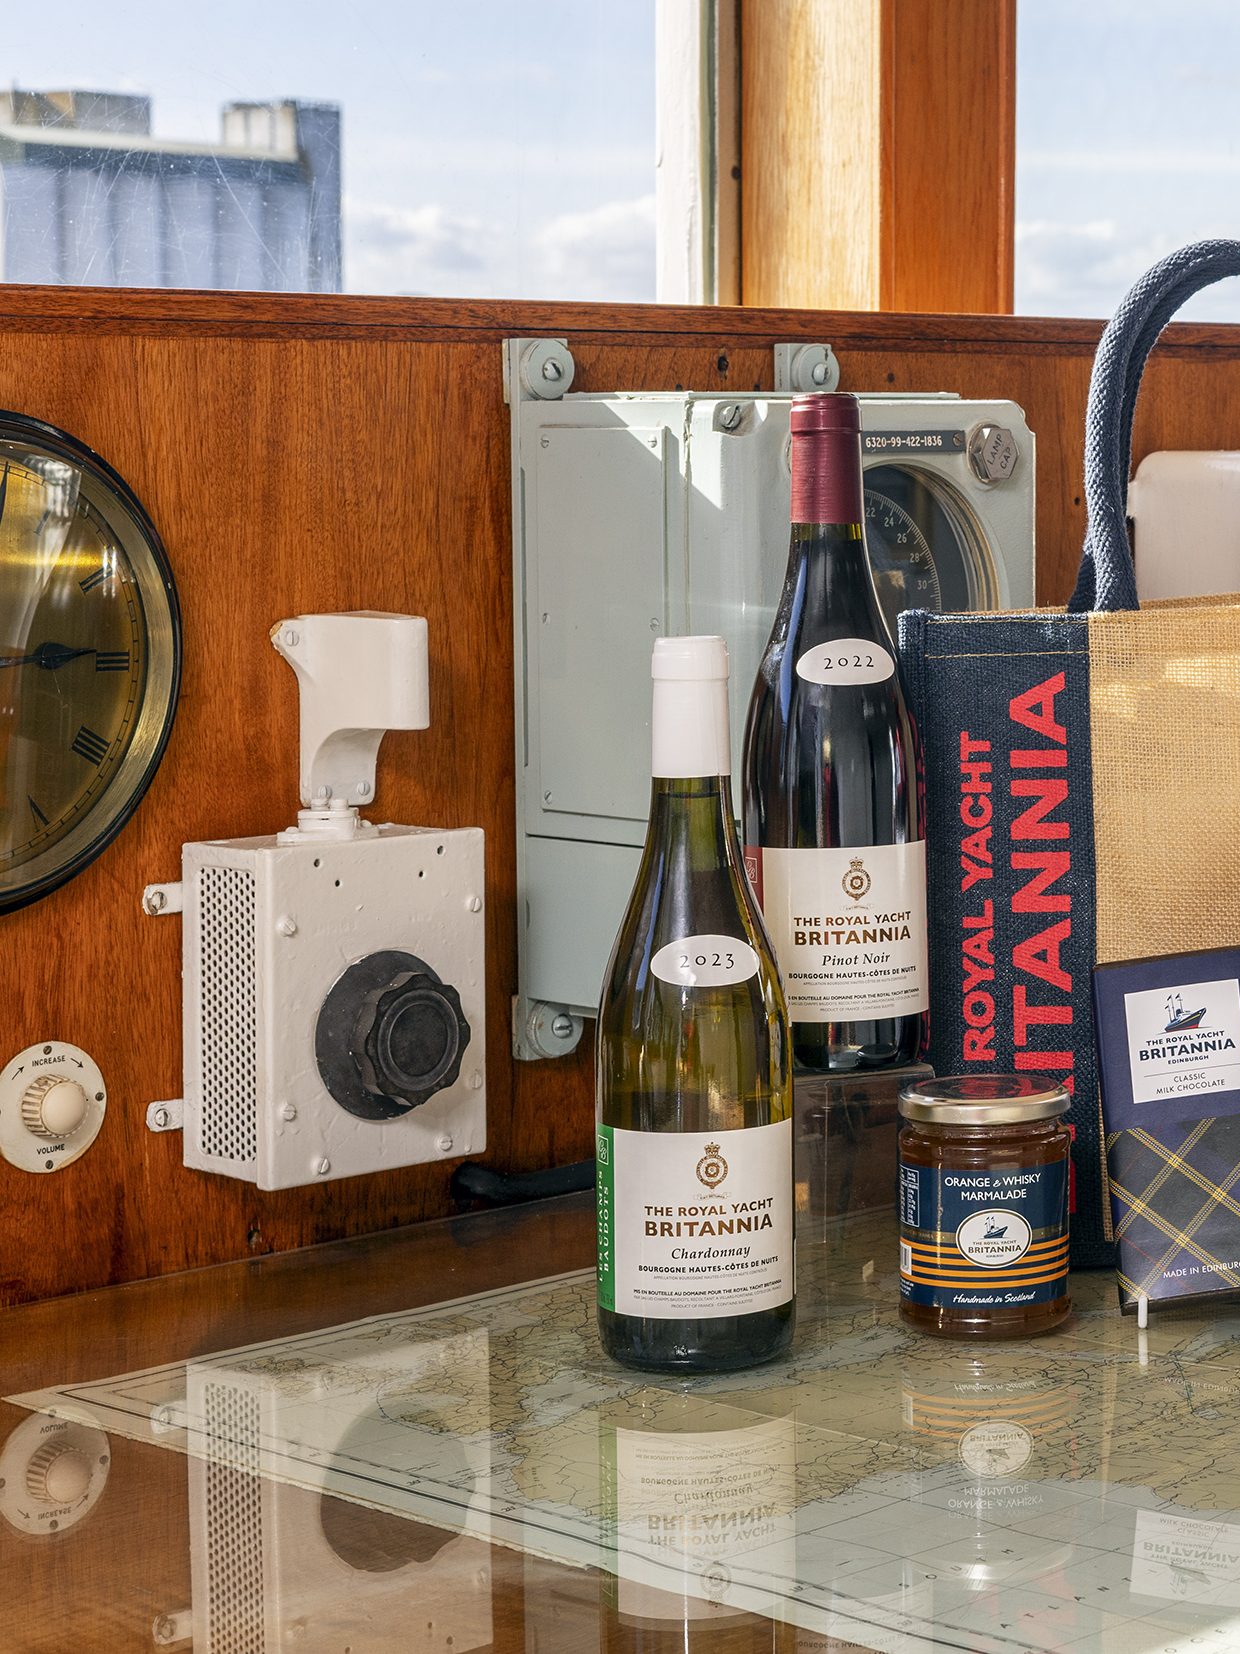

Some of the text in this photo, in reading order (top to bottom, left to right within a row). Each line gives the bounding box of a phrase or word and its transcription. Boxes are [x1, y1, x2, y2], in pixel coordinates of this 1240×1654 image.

[866, 435, 942, 448] 6320-99-422-1836
[987, 434, 1002, 465] LAMP
[1000, 446, 1012, 469] CAP
[866, 508, 876, 517] 22
[884, 517, 894, 527] 24
[897, 533, 907, 543] 26
[910, 553, 920, 563] 28
[917, 580, 927, 590] 30
[95, 651, 130, 672] III
[824, 655, 874, 669] 2022
[71, 725, 112, 769] IIII
[27, 795, 50, 833] V
[1008, 672, 1075, 1095] ITANNIA
[960, 731, 994, 1062] ROYAL YACHT
[794, 911, 911, 926] THE ROYAL YACHT
[794, 925, 911, 946] BRITANNIA
[680, 953, 734, 969] 2023
[822, 952, 890, 966] Pinot Noir
[901, 965, 916, 973] NUITS
[1146, 1030, 1225, 1046] THE ROYAL YACHT
[1139, 1038, 1236, 1062] BRITANNIA
[32, 1055, 66, 1067] INCREASE
[1168, 1054, 1209, 1065] EDINBURGH
[1173, 1072, 1206, 1083] CLASSIC
[1156, 1079, 1225, 1094] MILK CHOCOLATE
[37, 1144, 65, 1155] VOLUME
[944, 1173, 1041, 1187] ORANGE & WHISKY
[961, 1189, 1026, 1200] MARMALADE
[644, 1198, 773, 1216] THE ROYAL YACHT
[645, 1213, 773, 1237] BRITANNIA
[671, 1246, 750, 1261] Chardonnay
[968, 1244, 1022, 1253] BRITANNIA
[638, 1255, 779, 1273] BOURGOGNE HAUTES-CÔTES DE NUITS
[1163, 1268, 1186, 1279] MADE
[1189, 1267, 1199, 1275] IN
[953, 1294, 994, 1304] Handmade
[1004, 1291, 1036, 1301] Scotland
